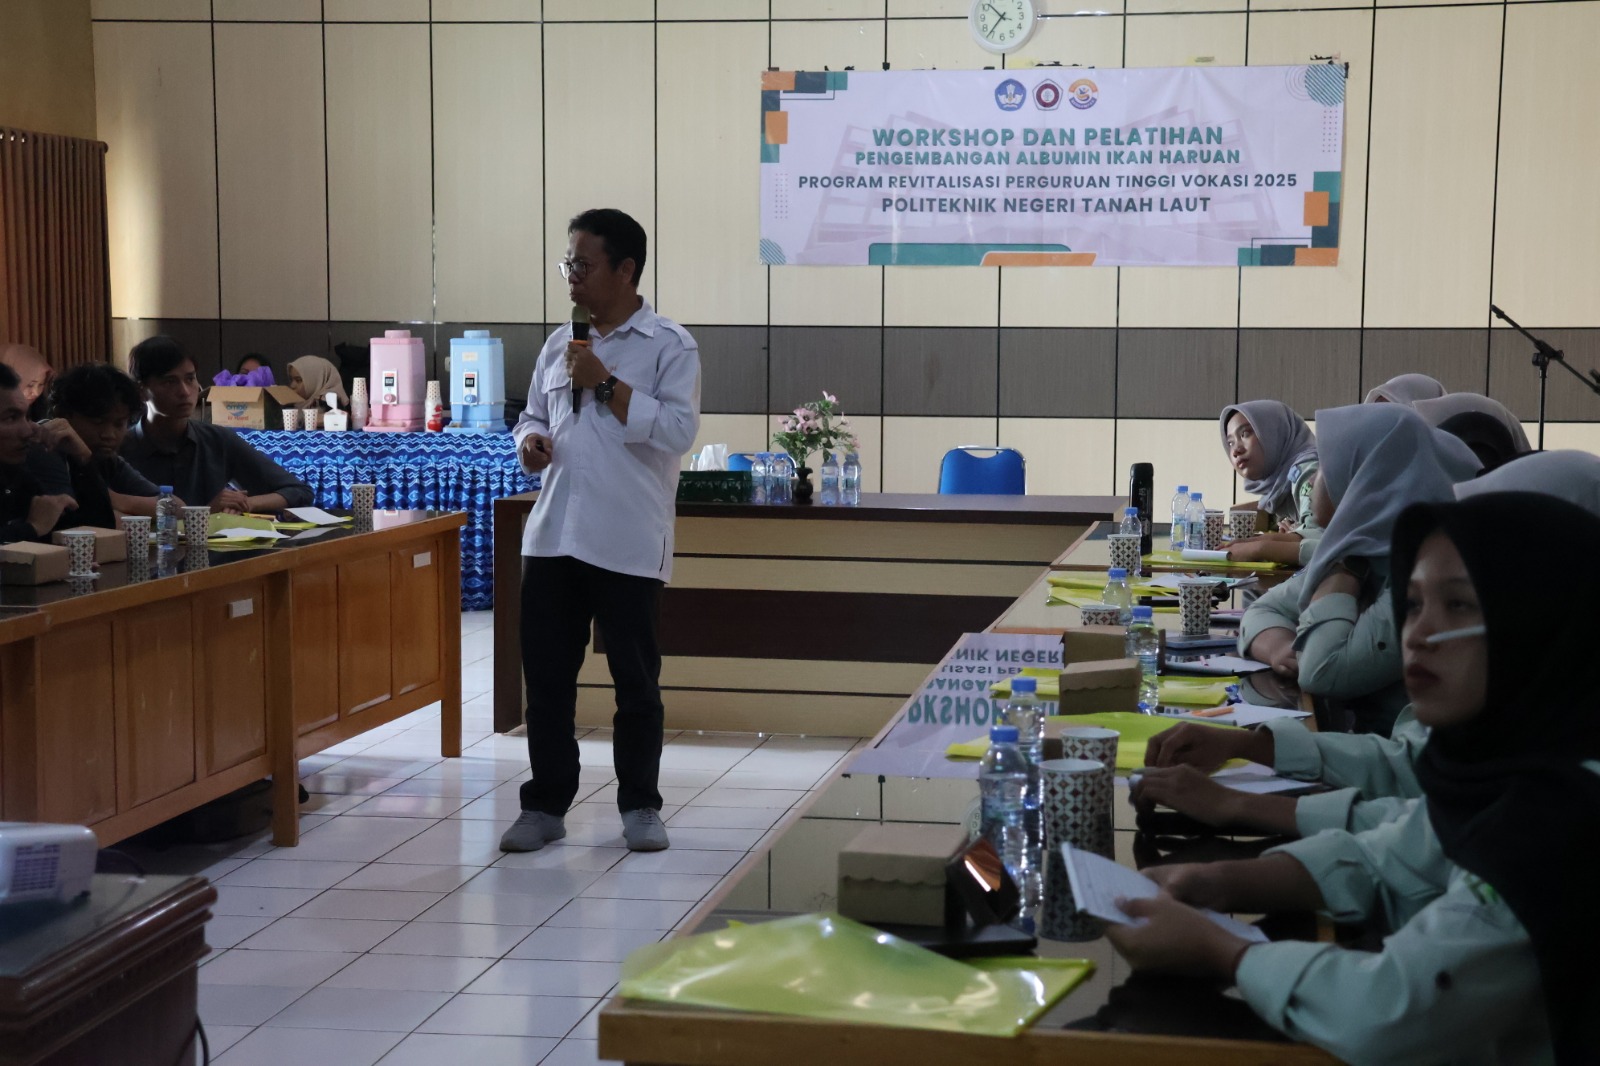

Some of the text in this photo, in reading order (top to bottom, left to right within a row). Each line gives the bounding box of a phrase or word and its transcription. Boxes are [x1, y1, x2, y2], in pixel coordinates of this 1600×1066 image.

[872, 126, 1223, 147] WORKSHOP DAN PELATIHAN
[855, 149, 1240, 166] PENGEMBANGAN ALBUMIN IKAN HARUAN
[798, 173, 1298, 189] PROGRAM REVITALISASI PERGURUAN TINGGI VOKASI 2025
[881, 196, 1212, 213] POLITEKNIK NEGERI TANAH LAUT
